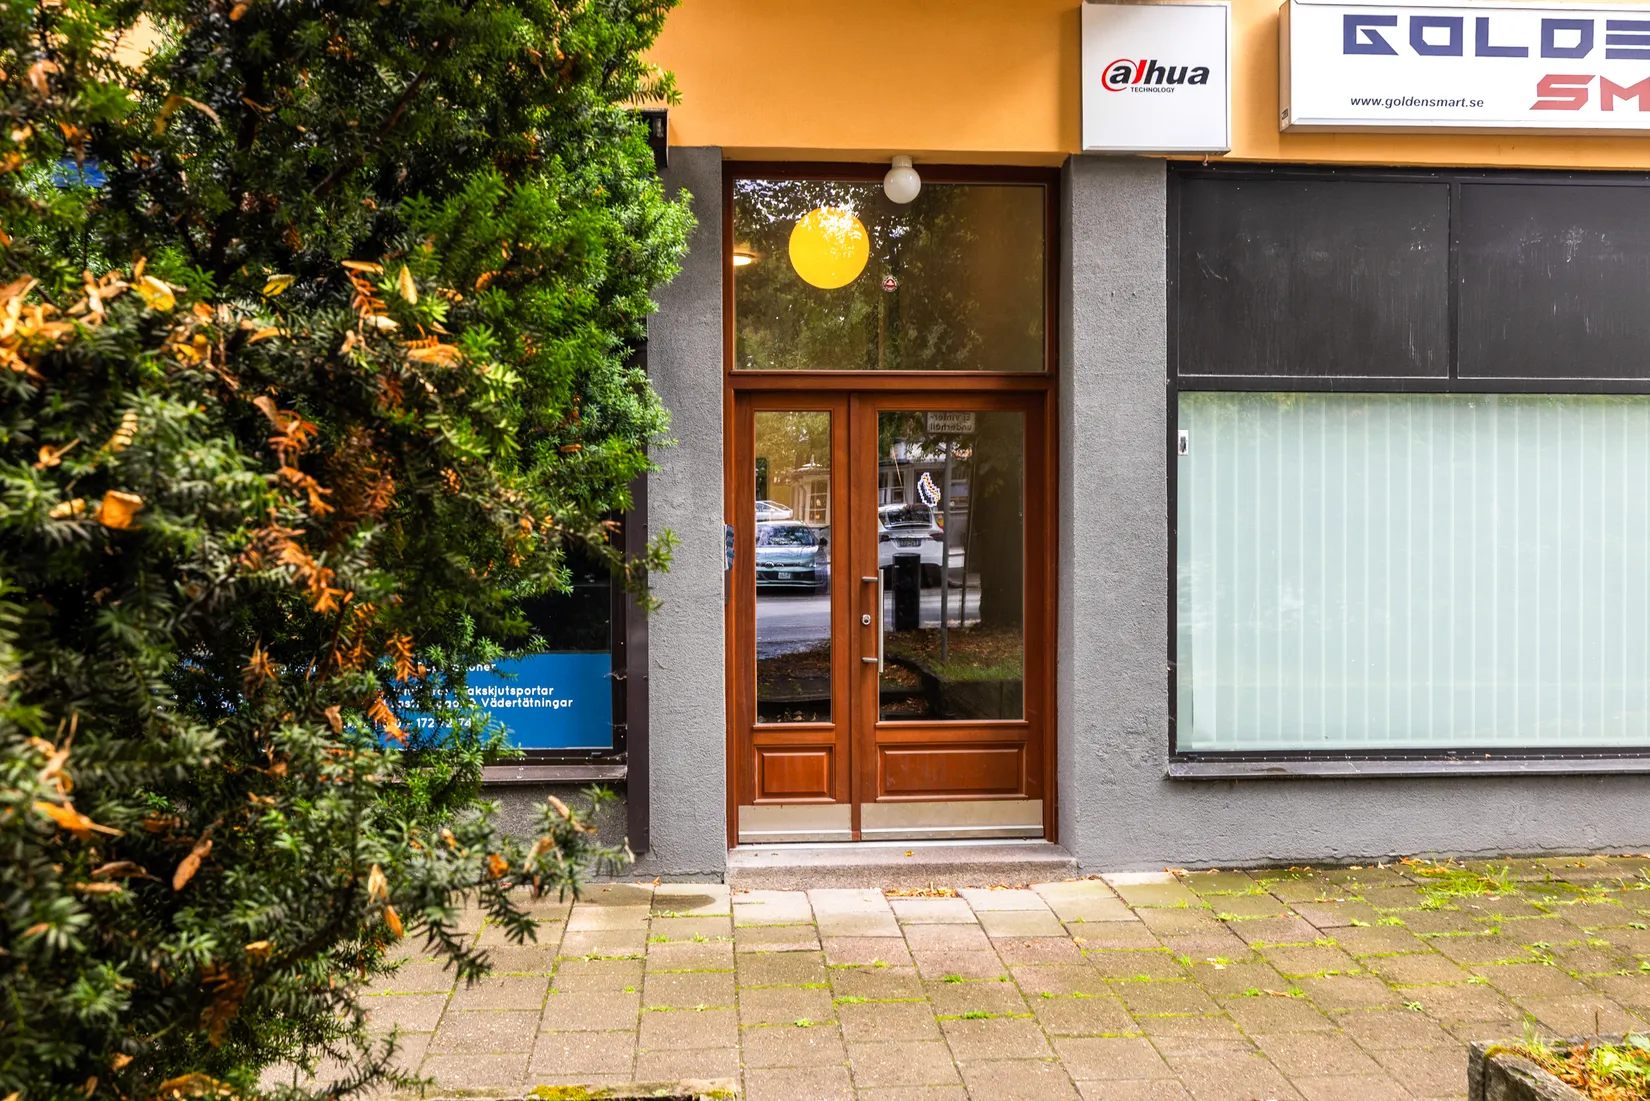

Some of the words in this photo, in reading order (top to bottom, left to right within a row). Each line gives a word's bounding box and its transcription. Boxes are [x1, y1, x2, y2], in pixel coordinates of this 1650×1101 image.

[1350, 96, 1484, 109] www.goldensmart.se
[465, 685, 554, 698] akskjutsportar
[481, 697, 573, 710] Vädertätningar
[416, 717, 435, 729] 172
